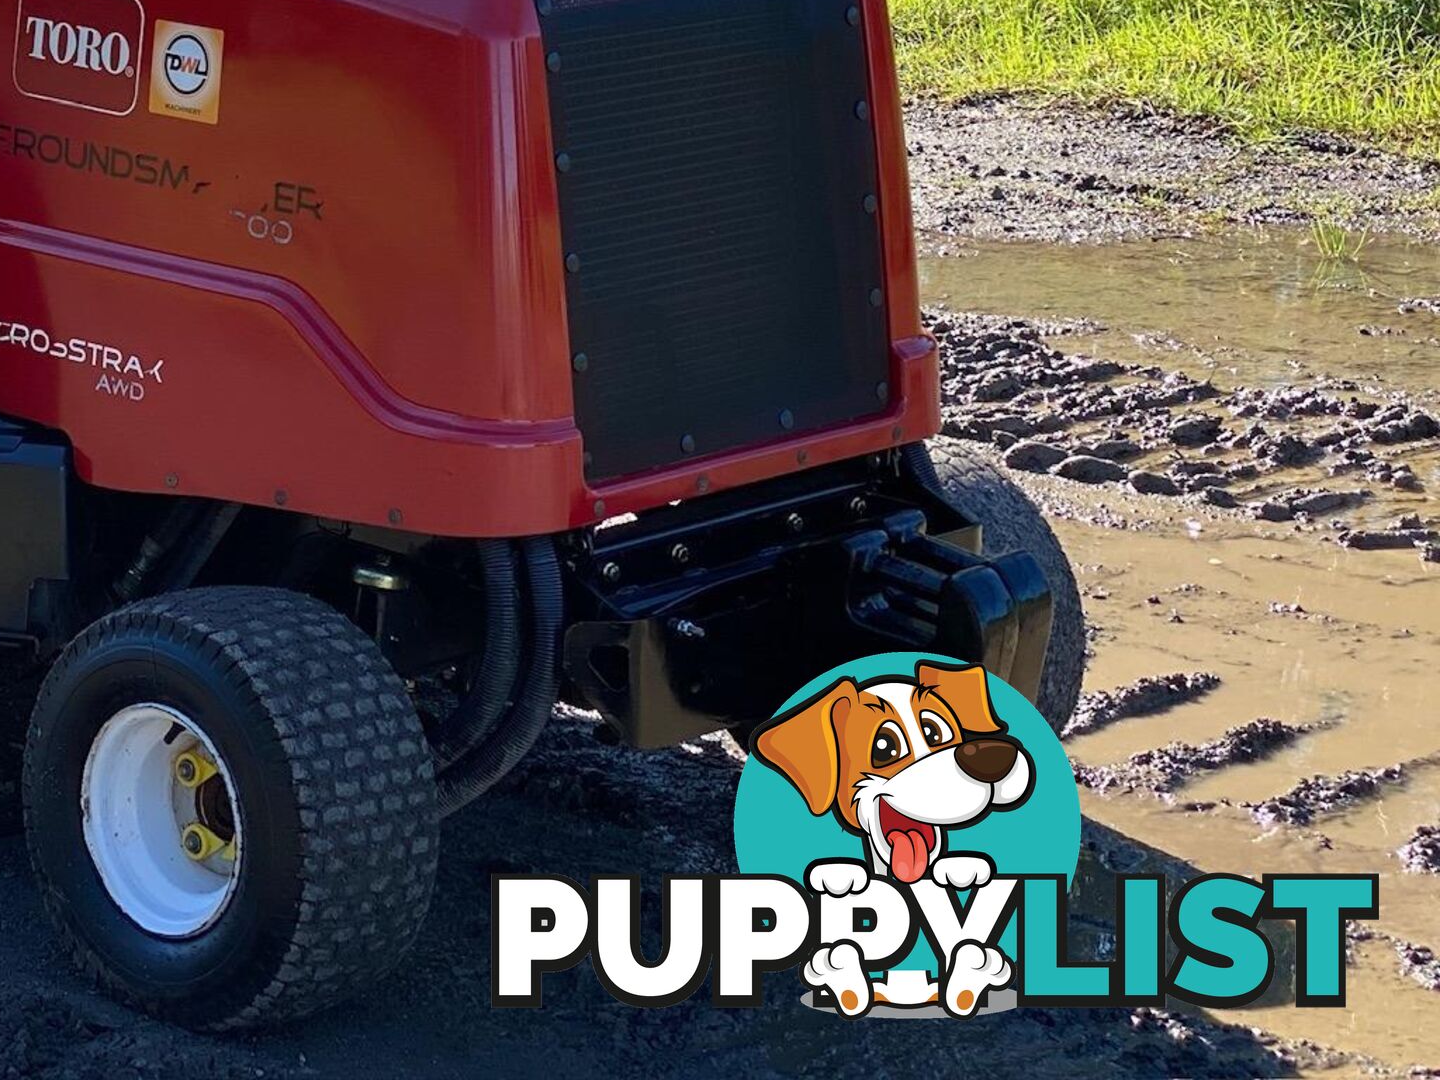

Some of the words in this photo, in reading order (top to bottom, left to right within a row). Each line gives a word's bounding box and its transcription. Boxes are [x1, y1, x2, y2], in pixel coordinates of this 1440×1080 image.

[25, 16, 130, 76] TORO
[165, 52, 208, 77] DWL
[95, 373, 145, 401] AWD
